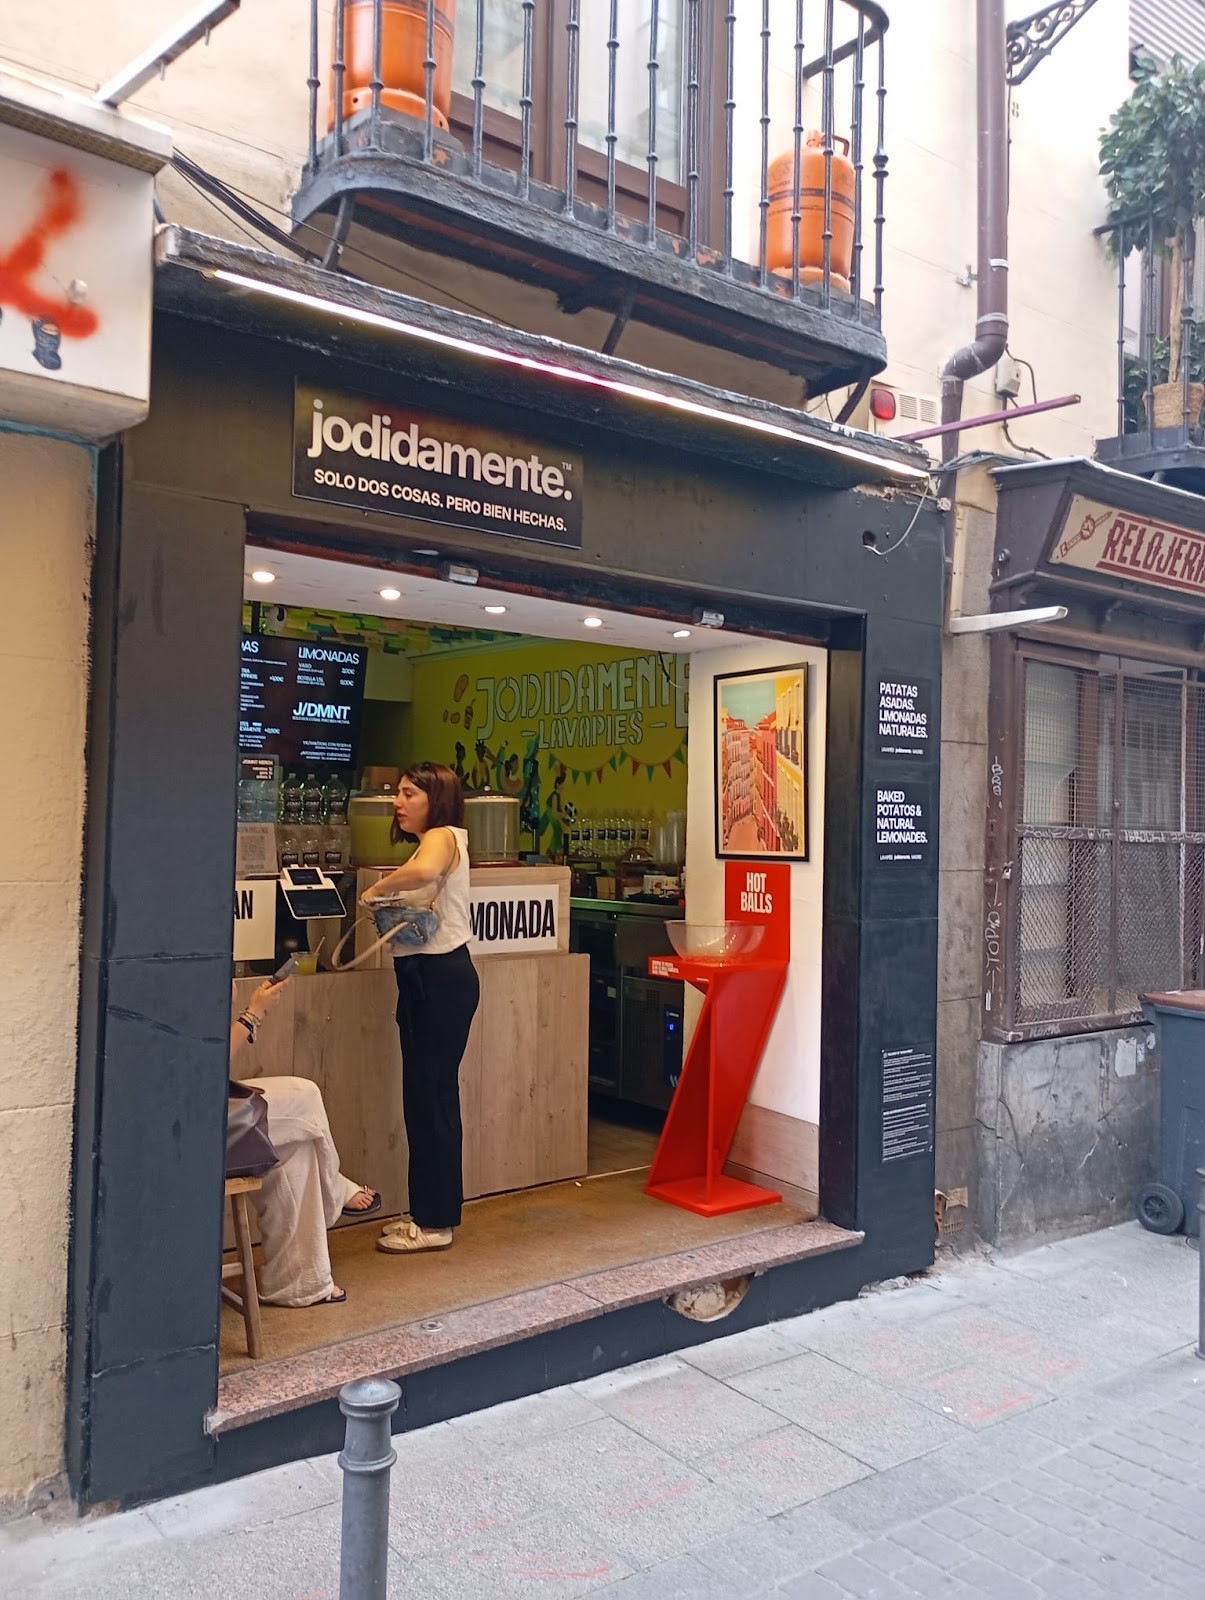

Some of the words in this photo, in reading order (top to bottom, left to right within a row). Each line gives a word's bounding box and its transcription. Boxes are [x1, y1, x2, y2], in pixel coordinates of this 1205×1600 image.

[307, 398, 573, 501] jodidamente.
[313, 468, 356, 490] SOLO
[358, 477, 389, 497] DOS
[391, 484, 444, 508] COSAS.
[446, 495, 481, 515] PERO
[483, 505, 512, 521] BIEN
[513, 509, 567, 532] HECHAS.
[298, 647, 360, 665] LIMONADAS
[476, 652, 690, 741] JODIDAMENTE
[879, 682, 918, 698] PATATAS
[293, 702, 351, 720] J/DMNT
[879, 696, 915, 711] ASADAS.
[879, 710, 927, 725] LIMONADAS
[538, 711, 644, 749] LAVAPIES
[879, 723, 928, 738] NATURALES.
[877, 790, 905, 802] BAKED
[877, 818, 915, 830] NATURAL
[876, 831, 928, 844] LEMONADES.
[747, 872, 767, 893] HOT
[740, 891, 773, 914] BALLS
